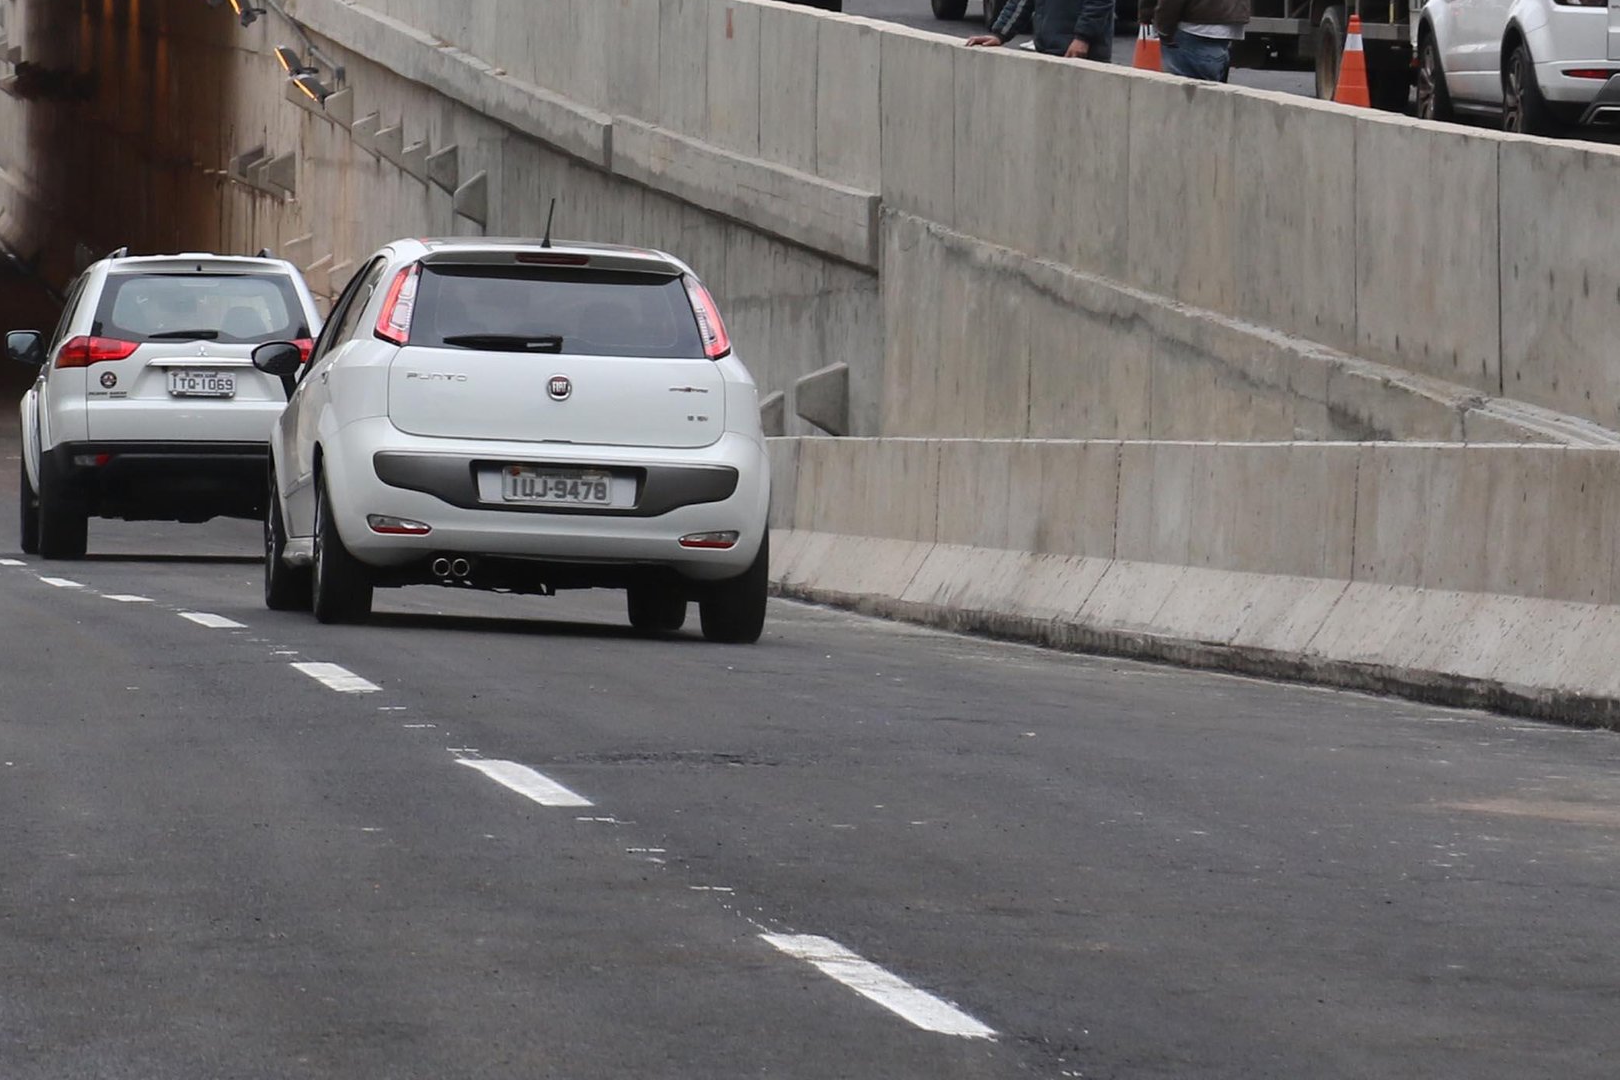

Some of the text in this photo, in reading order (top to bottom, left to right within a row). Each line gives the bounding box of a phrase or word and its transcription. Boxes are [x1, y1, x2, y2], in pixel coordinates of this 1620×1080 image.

[407, 372, 467, 381] PUNTO
[172, 378, 234, 390] ITQ-1069
[552, 381, 568, 393] FIAT
[512, 478, 607, 500] IUJ-9478
